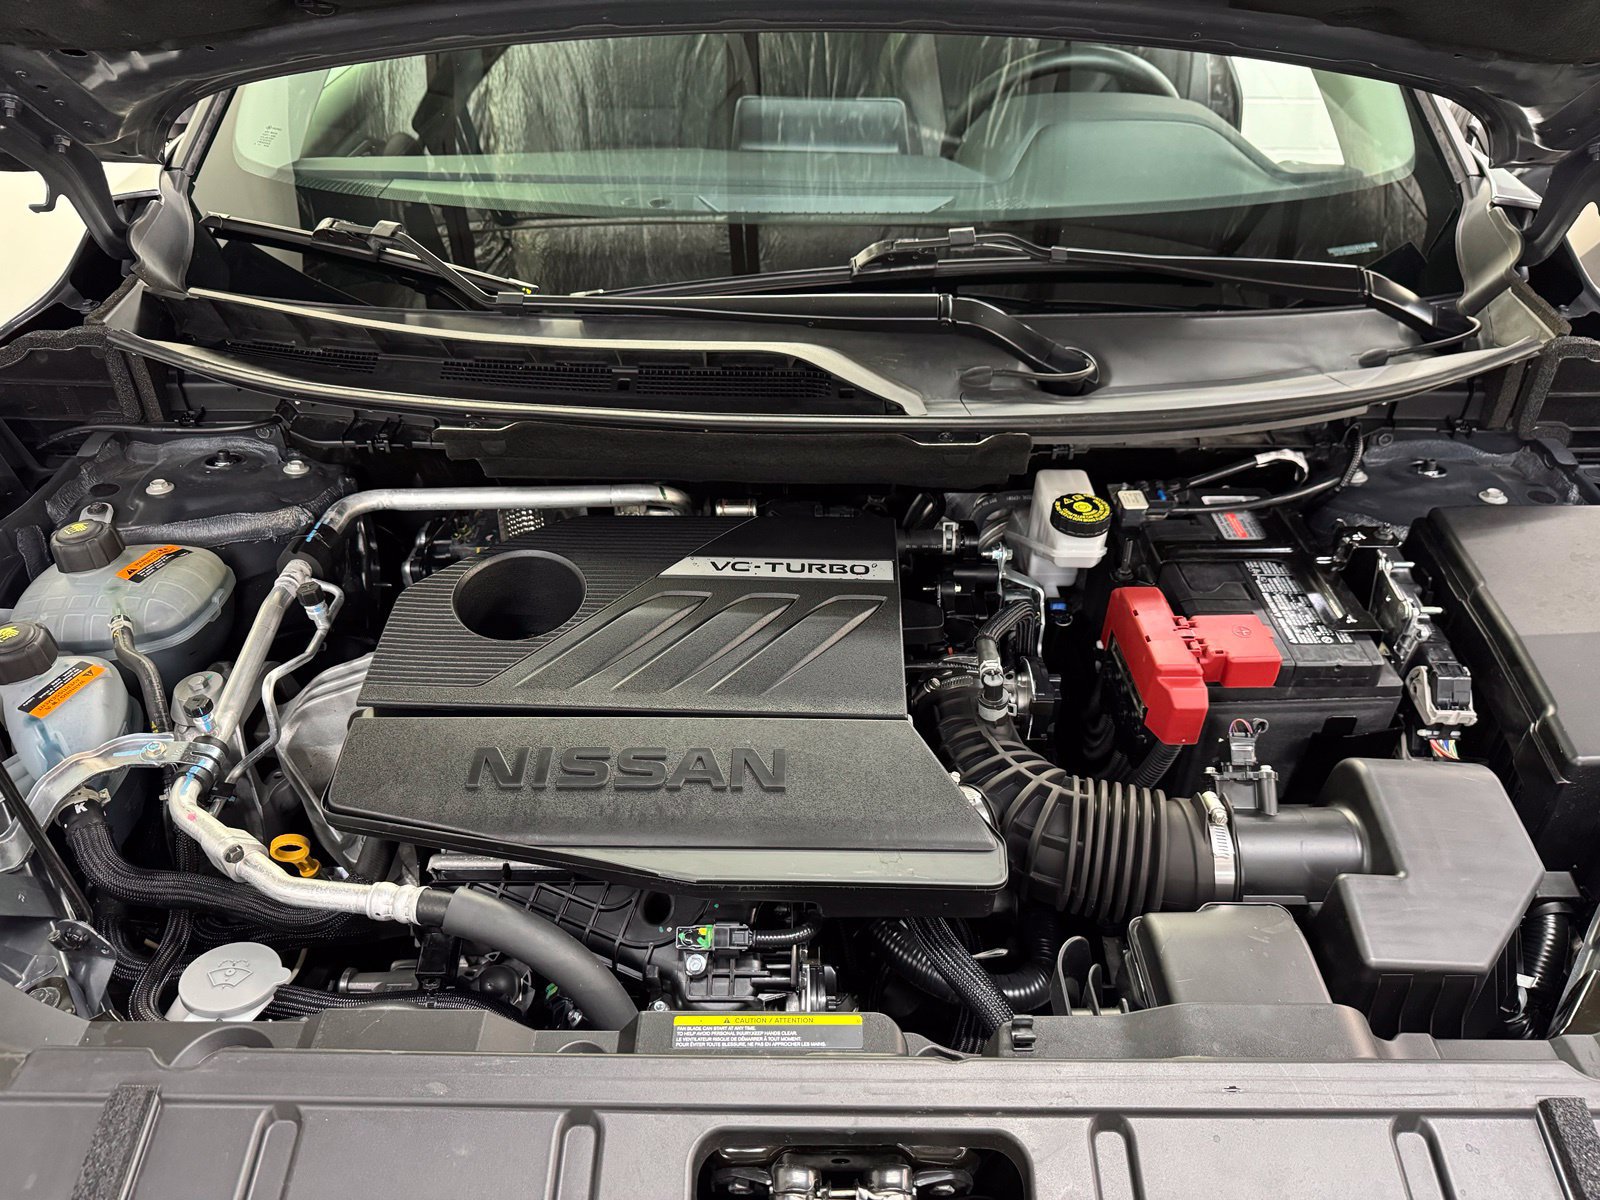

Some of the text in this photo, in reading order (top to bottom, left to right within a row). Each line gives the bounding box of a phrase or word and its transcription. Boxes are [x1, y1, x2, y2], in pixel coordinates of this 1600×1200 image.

[710, 561, 870, 575] VC-TURBO
[465, 746, 787, 790] NISSAN
[74, 802, 88, 814] K
